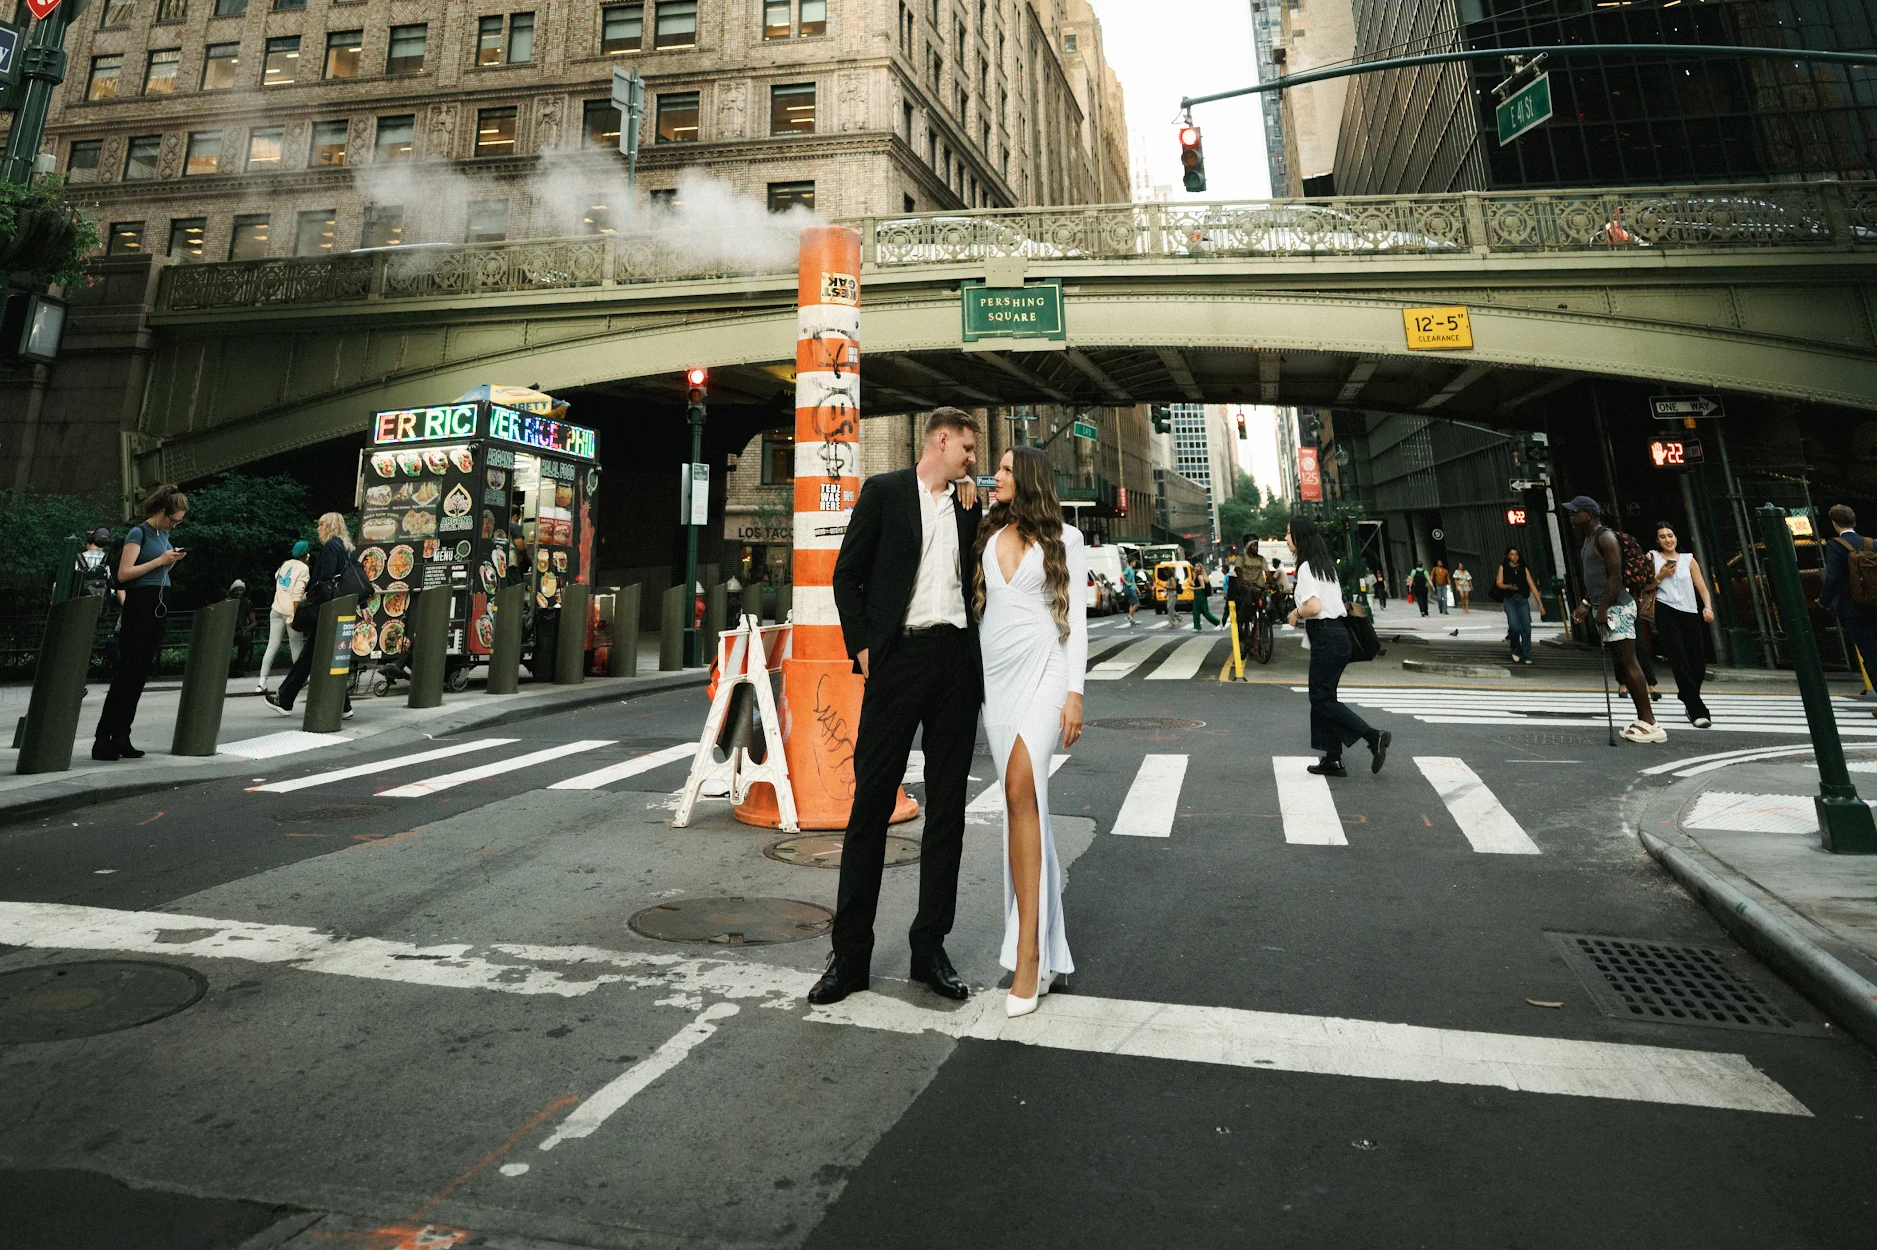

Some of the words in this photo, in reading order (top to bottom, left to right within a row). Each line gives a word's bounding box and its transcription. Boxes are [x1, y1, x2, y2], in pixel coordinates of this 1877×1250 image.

[1510, 105, 1517, 129] E
[1524, 95, 1534, 120] St
[980, 297, 1045, 308] PERSHING
[988, 312, 1037, 322] SQUARE
[1418, 334, 1460, 343] CLEARANCE
[1658, 403, 1678, 412] ONE
[1690, 401, 1710, 411] WAY
[378, 413, 417, 441] ER
[424, 408, 472, 438] RIC
[523, 416, 562, 450] RICE
[486, 447, 515, 470] ARGANA
[1666, 442, 1685, 464] 22
[559, 462, 576, 481] FOOD
[1301, 471, 1319, 486] 125
[820, 483, 841, 494] TEDZ
[820, 492, 841, 502] WAS
[820, 501, 841, 511] HERE
[440, 516, 473, 525] ARGANA
[1515, 510, 1526, 524] 22
[738, 527, 762, 538] LOS
[433, 550, 454, 562] MENU
